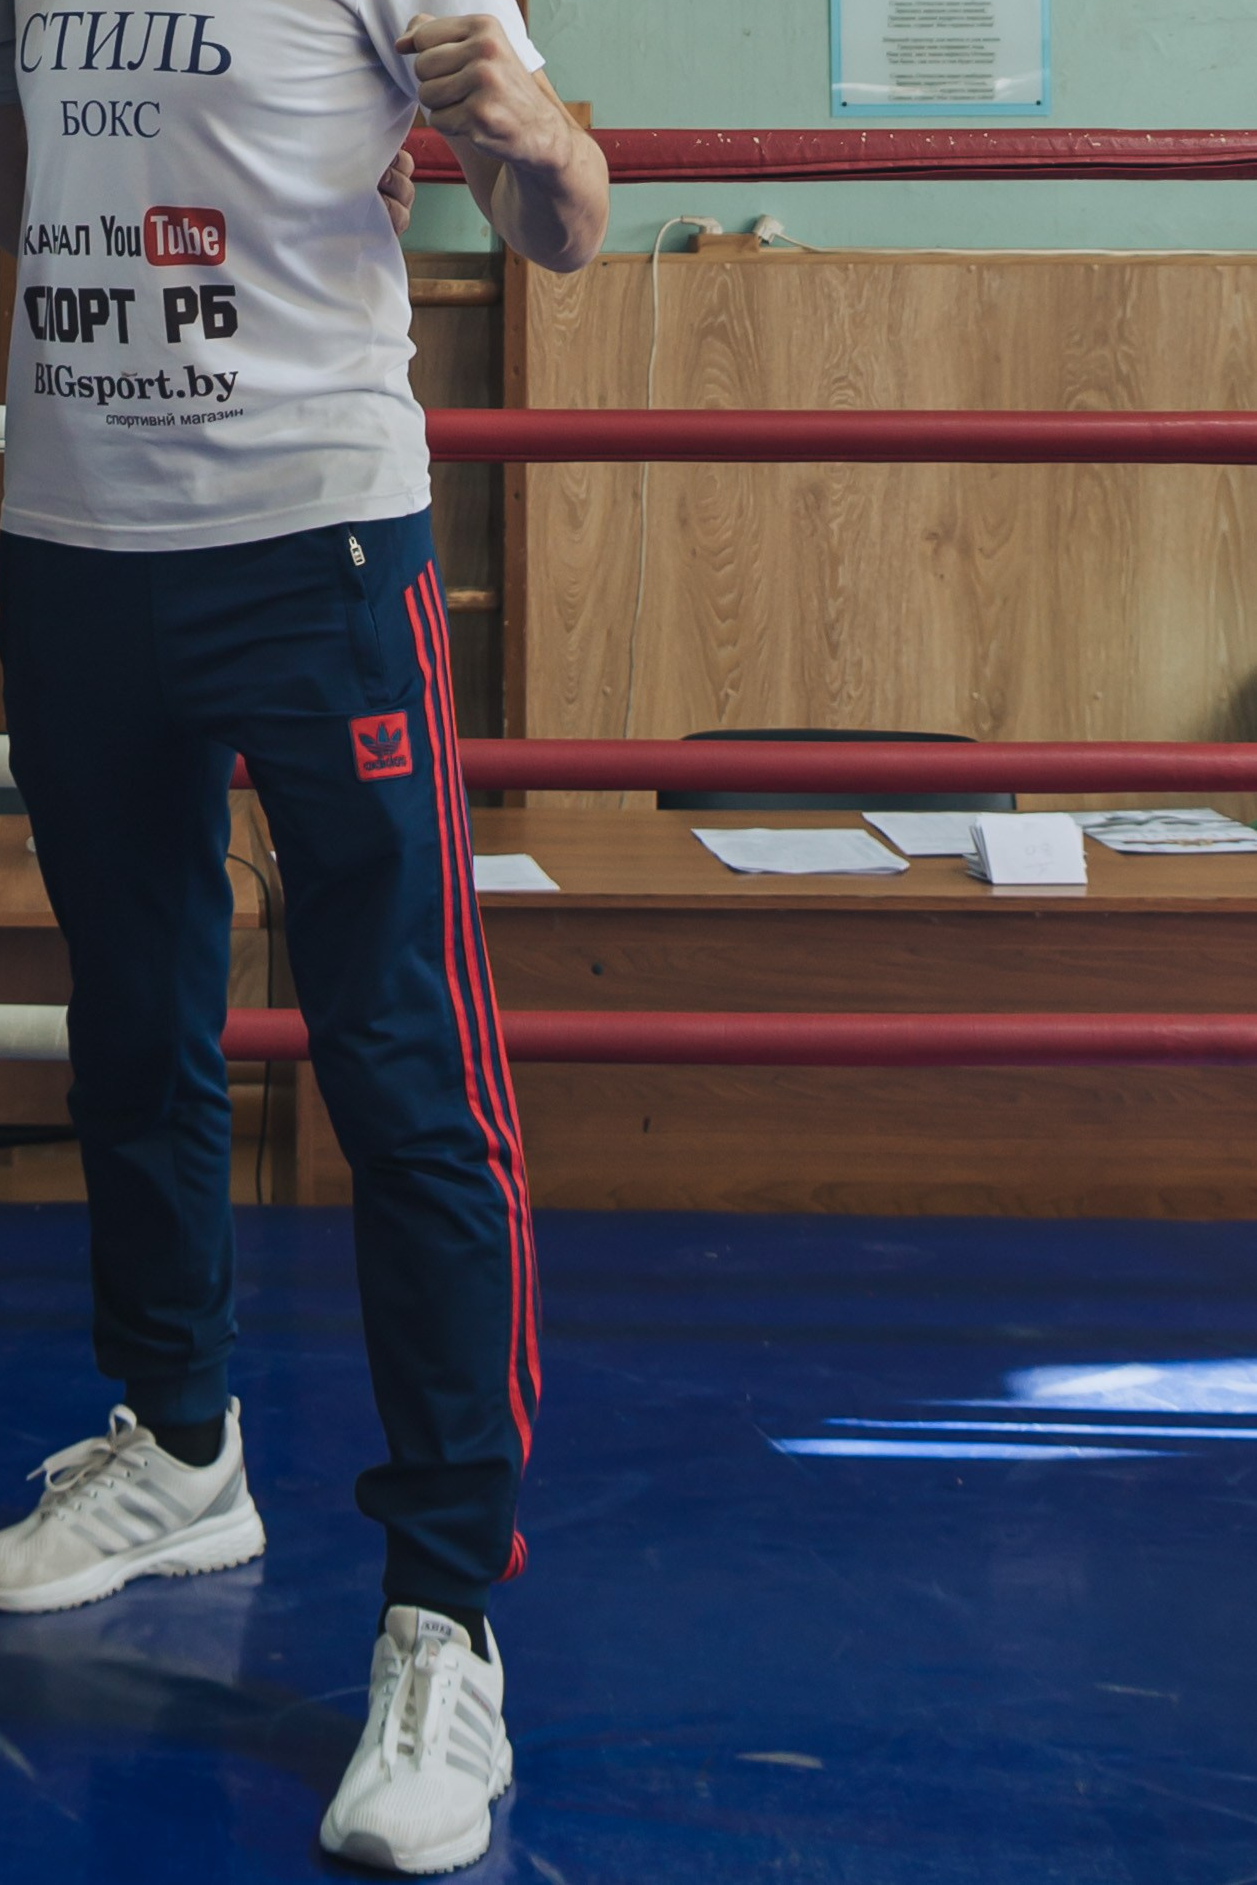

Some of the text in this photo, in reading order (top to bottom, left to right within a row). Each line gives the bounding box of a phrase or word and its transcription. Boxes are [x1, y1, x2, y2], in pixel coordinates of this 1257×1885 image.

[20, 11, 232, 76] СТИЛЬ
[61, 100, 162, 138] БОКС
[163, 284, 239, 344] РБ
[34, 362, 239, 406] BIGsport.by
[180, 408, 244, 426] магазин
